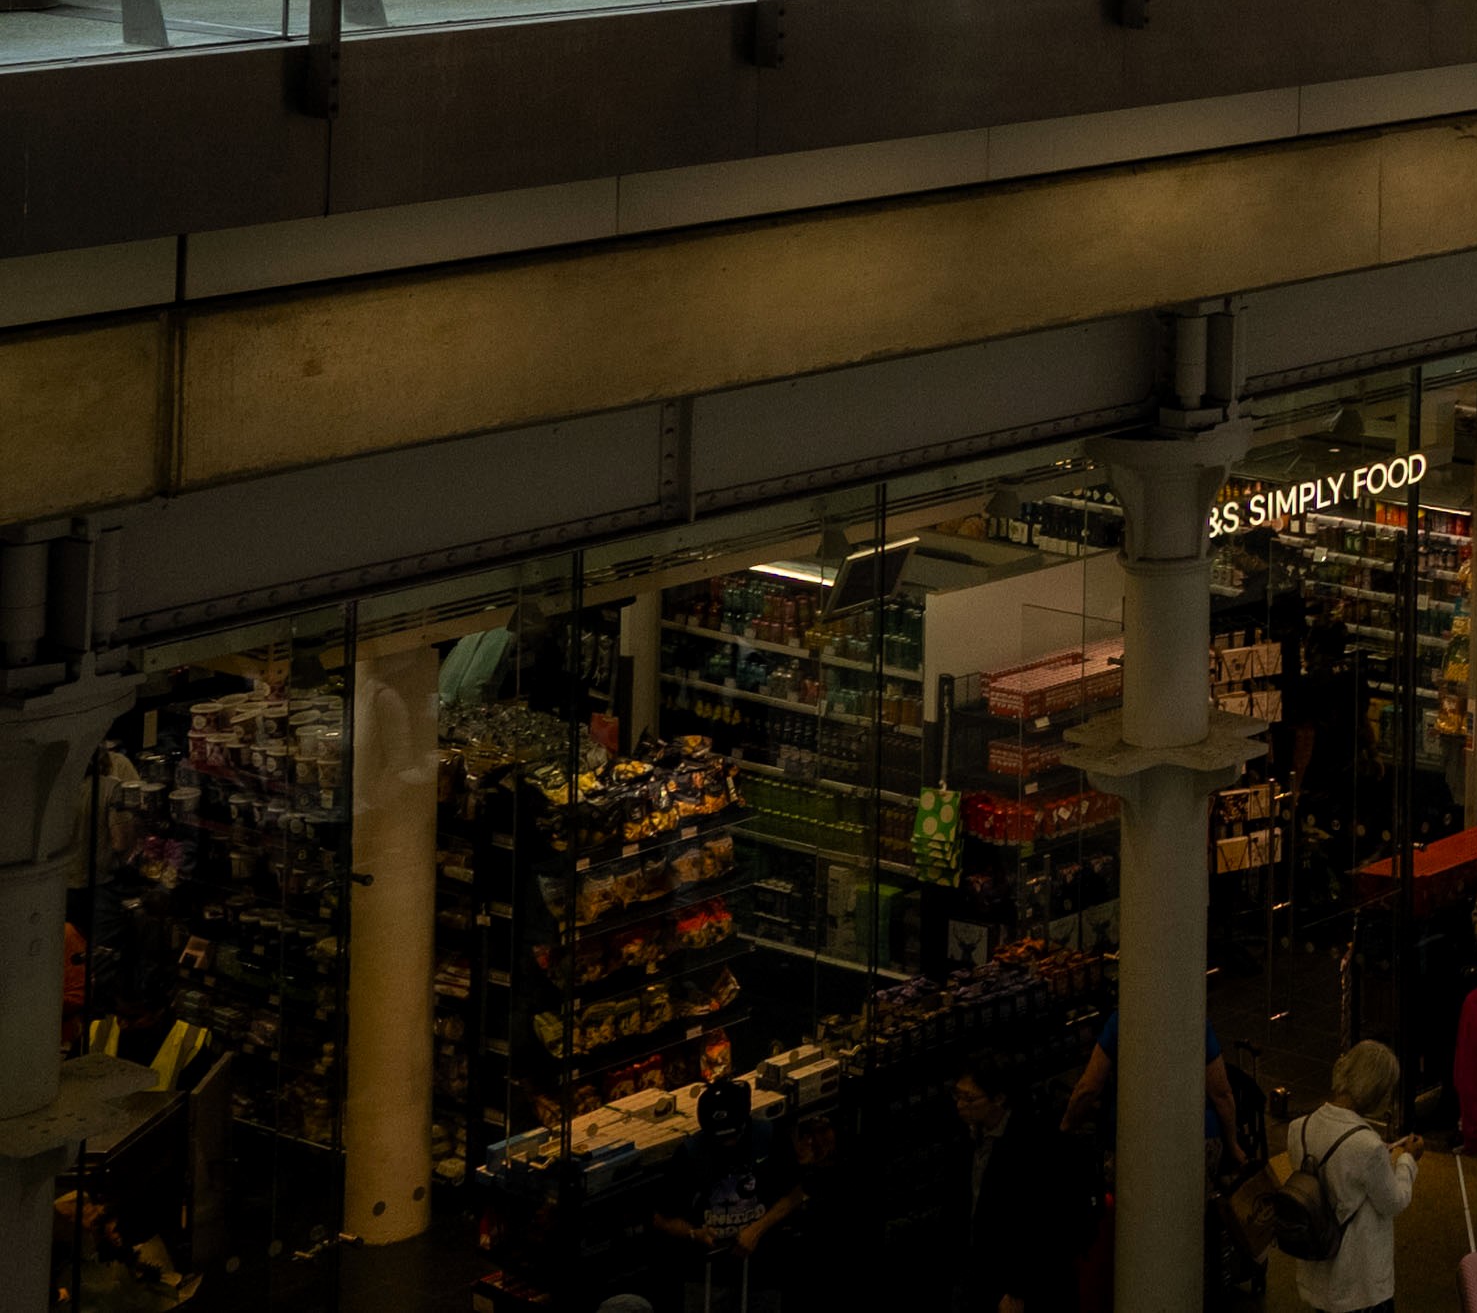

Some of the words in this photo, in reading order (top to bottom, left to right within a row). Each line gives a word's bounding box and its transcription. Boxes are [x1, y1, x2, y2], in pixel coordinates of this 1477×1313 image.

[1208, 501, 1240, 539] &S
[1248, 472, 1346, 526] SIMPLY
[1352, 453, 1428, 500] FOOD
